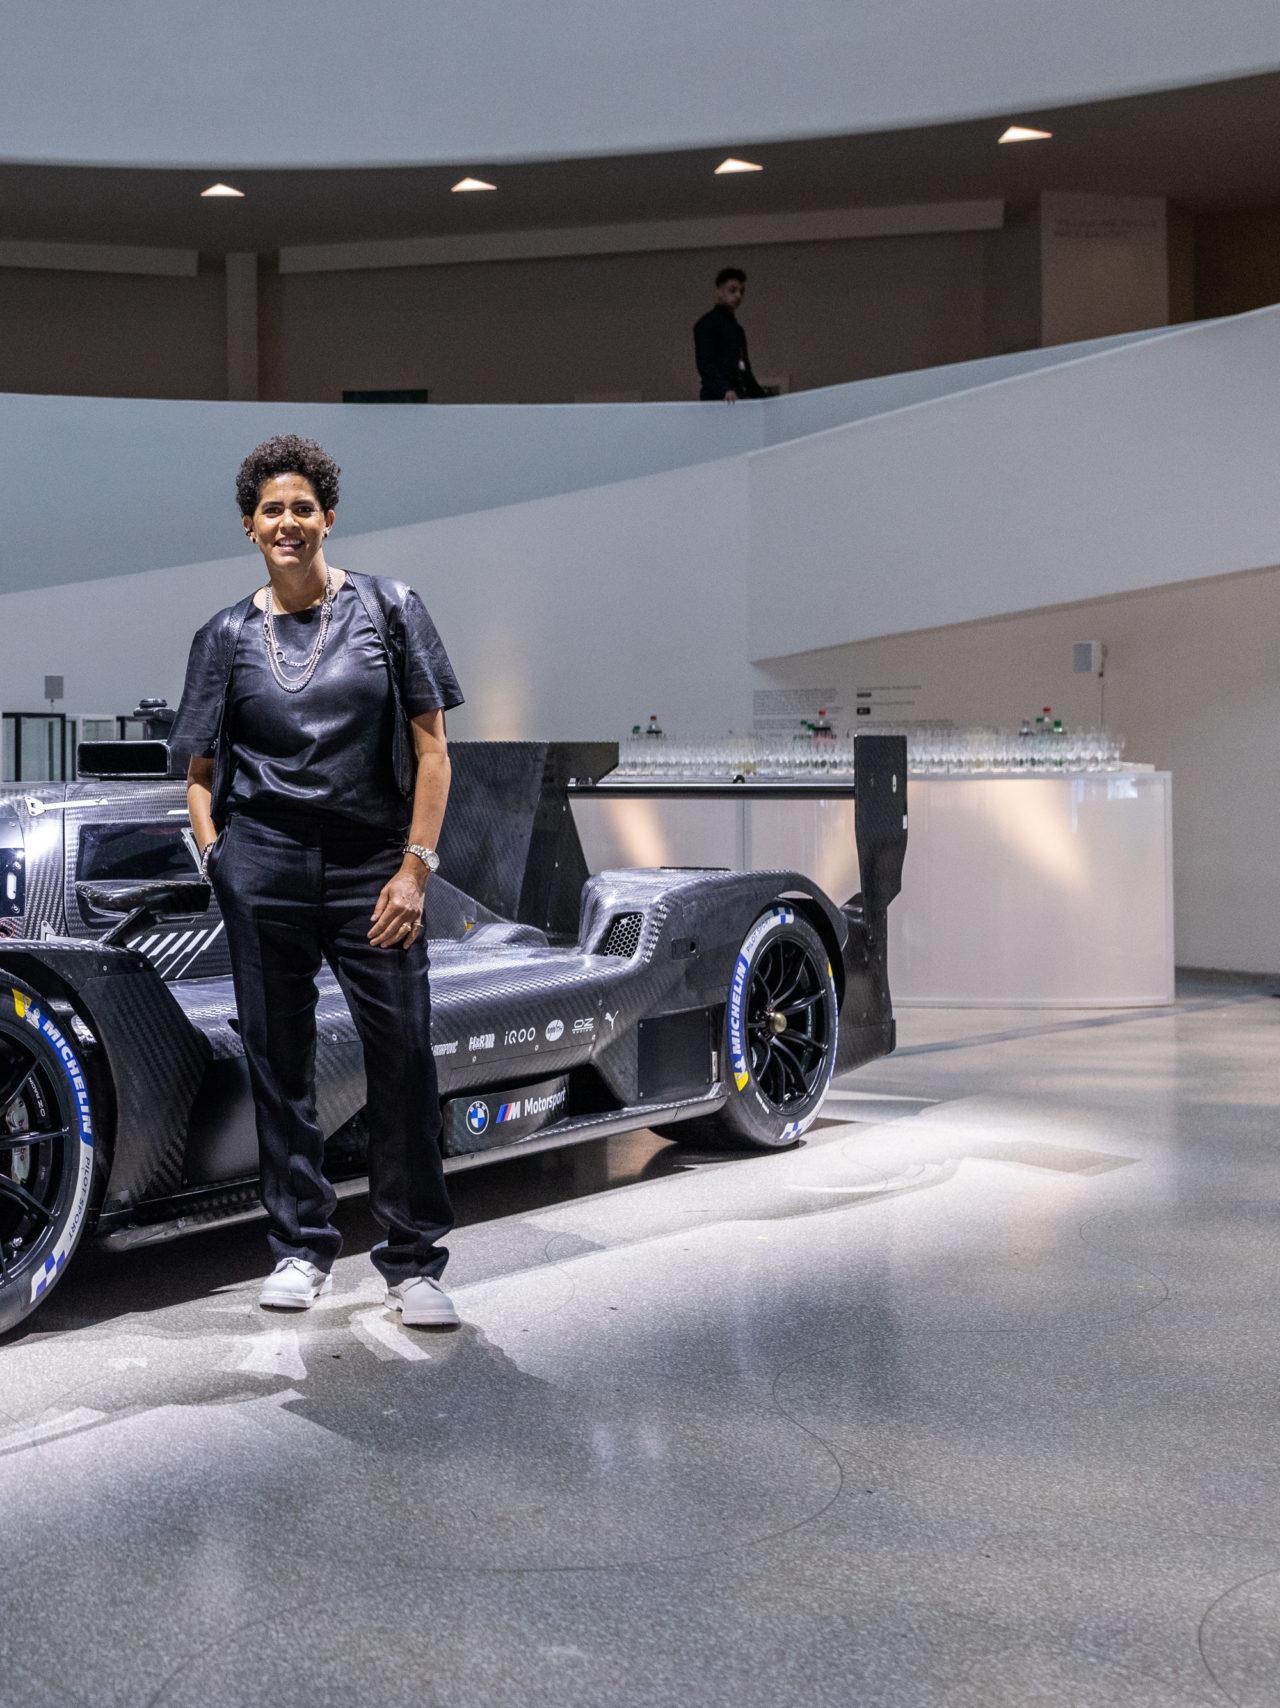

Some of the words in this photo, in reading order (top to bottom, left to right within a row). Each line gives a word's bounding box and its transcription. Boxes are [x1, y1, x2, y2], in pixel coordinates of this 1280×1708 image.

[573, 1017, 595, 1029] OZ
[730, 961, 747, 1055] MICHELIN
[504, 1027, 536, 1046] iQOO
[41, 1020, 93, 1136] MICHELIN
[524, 1087, 567, 1117] Motorsport
[78, 1155, 91, 1197] PILOT
[68, 1198, 86, 1241] SPORT
